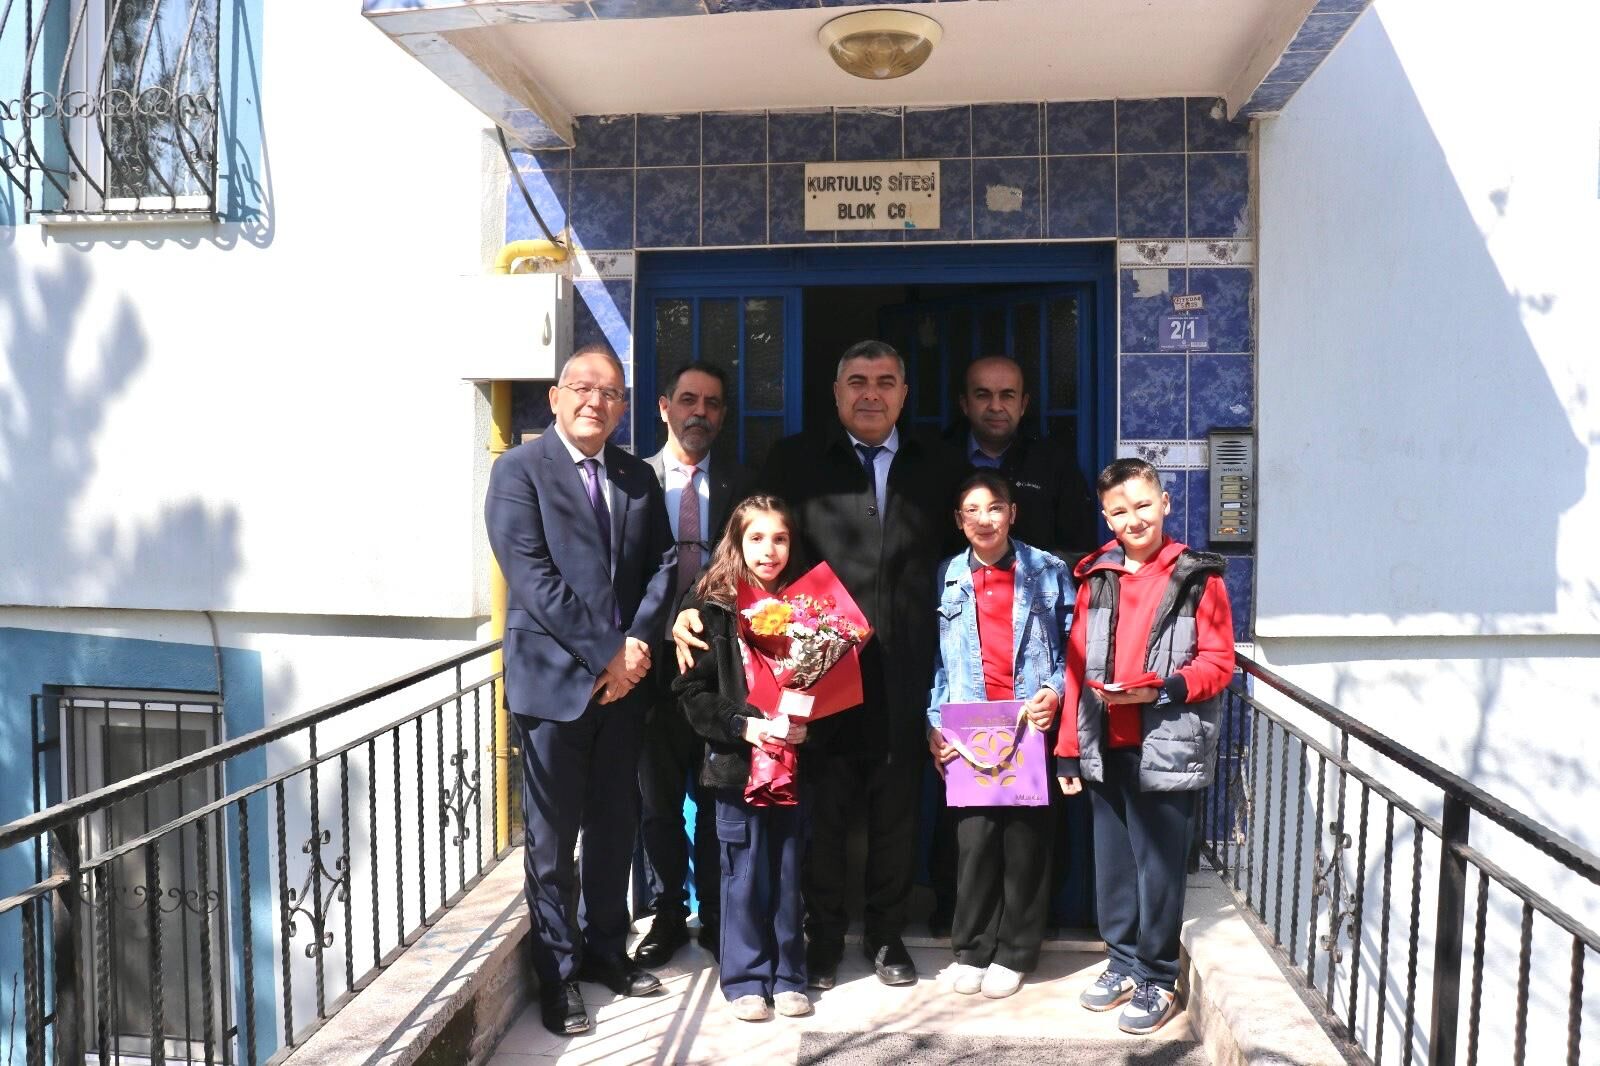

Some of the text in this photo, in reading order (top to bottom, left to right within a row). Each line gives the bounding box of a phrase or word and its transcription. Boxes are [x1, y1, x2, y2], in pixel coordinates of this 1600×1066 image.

[807, 171, 936, 195] KURTULUŞ SİTESİ
[837, 202, 907, 220] BLOK C6
[1170, 320, 1195, 339] 2/1
